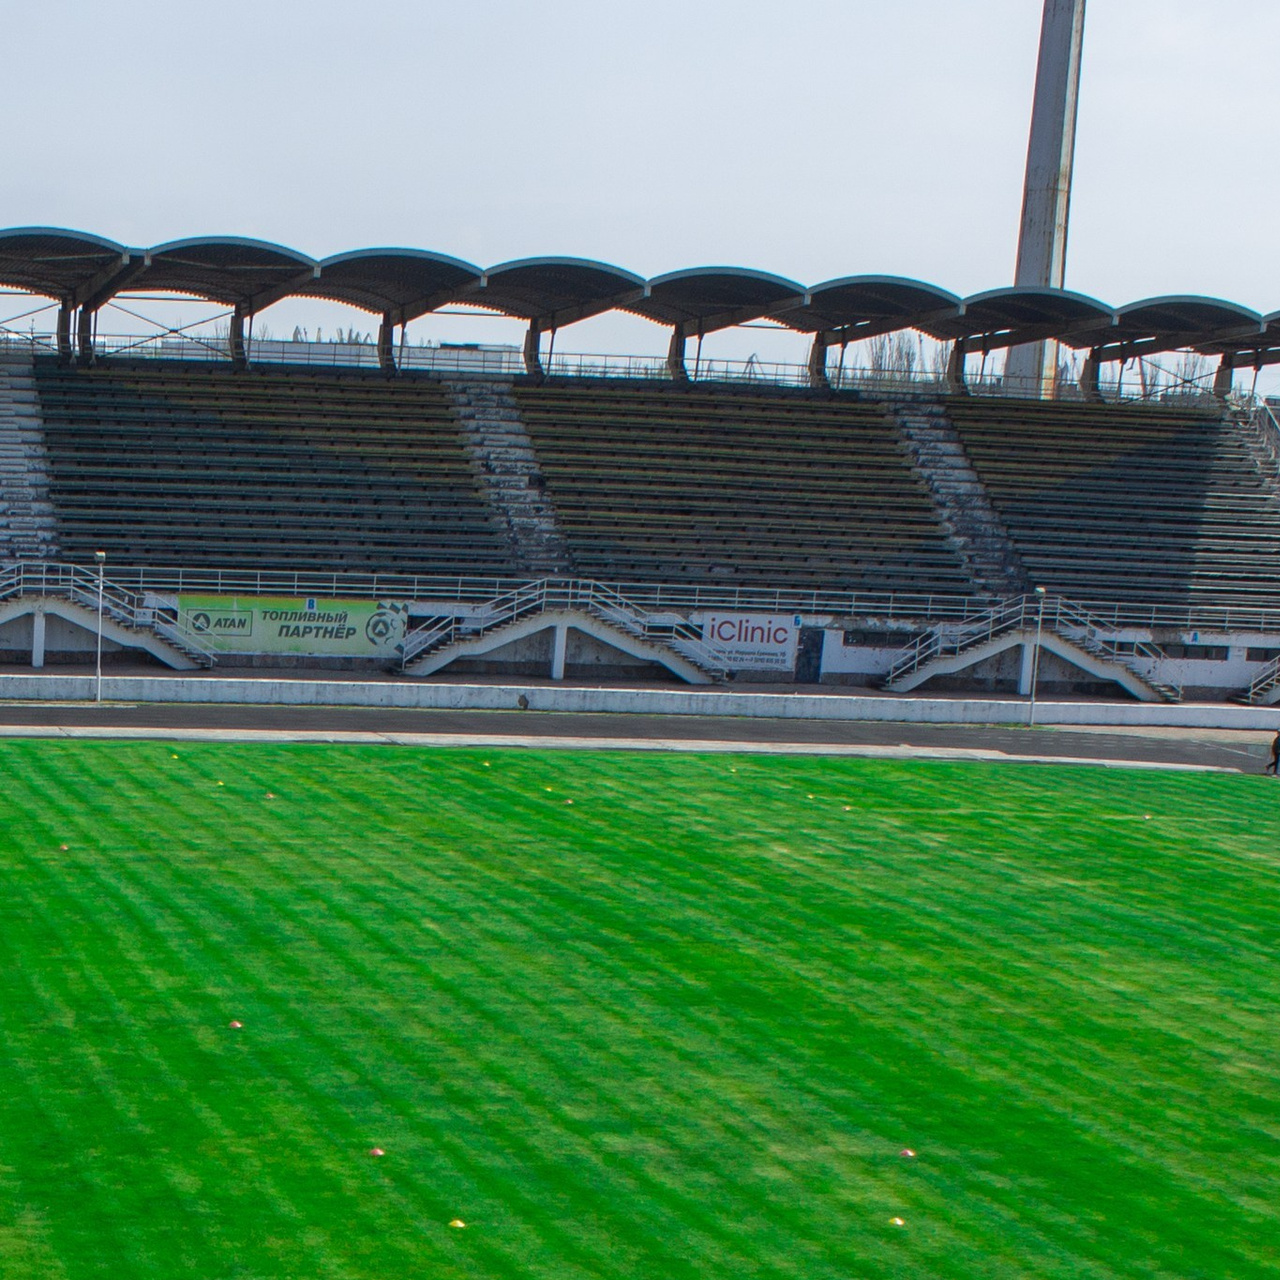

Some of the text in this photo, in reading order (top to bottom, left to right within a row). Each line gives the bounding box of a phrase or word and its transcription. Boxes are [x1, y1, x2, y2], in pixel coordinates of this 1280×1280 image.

[213, 618, 247, 629] ATAN
[262, 610, 348, 623] ТОПЛИВНЫЙ
[277, 622, 357, 640] ПАРТНЁР
[710, 617, 788, 644] iClinic
